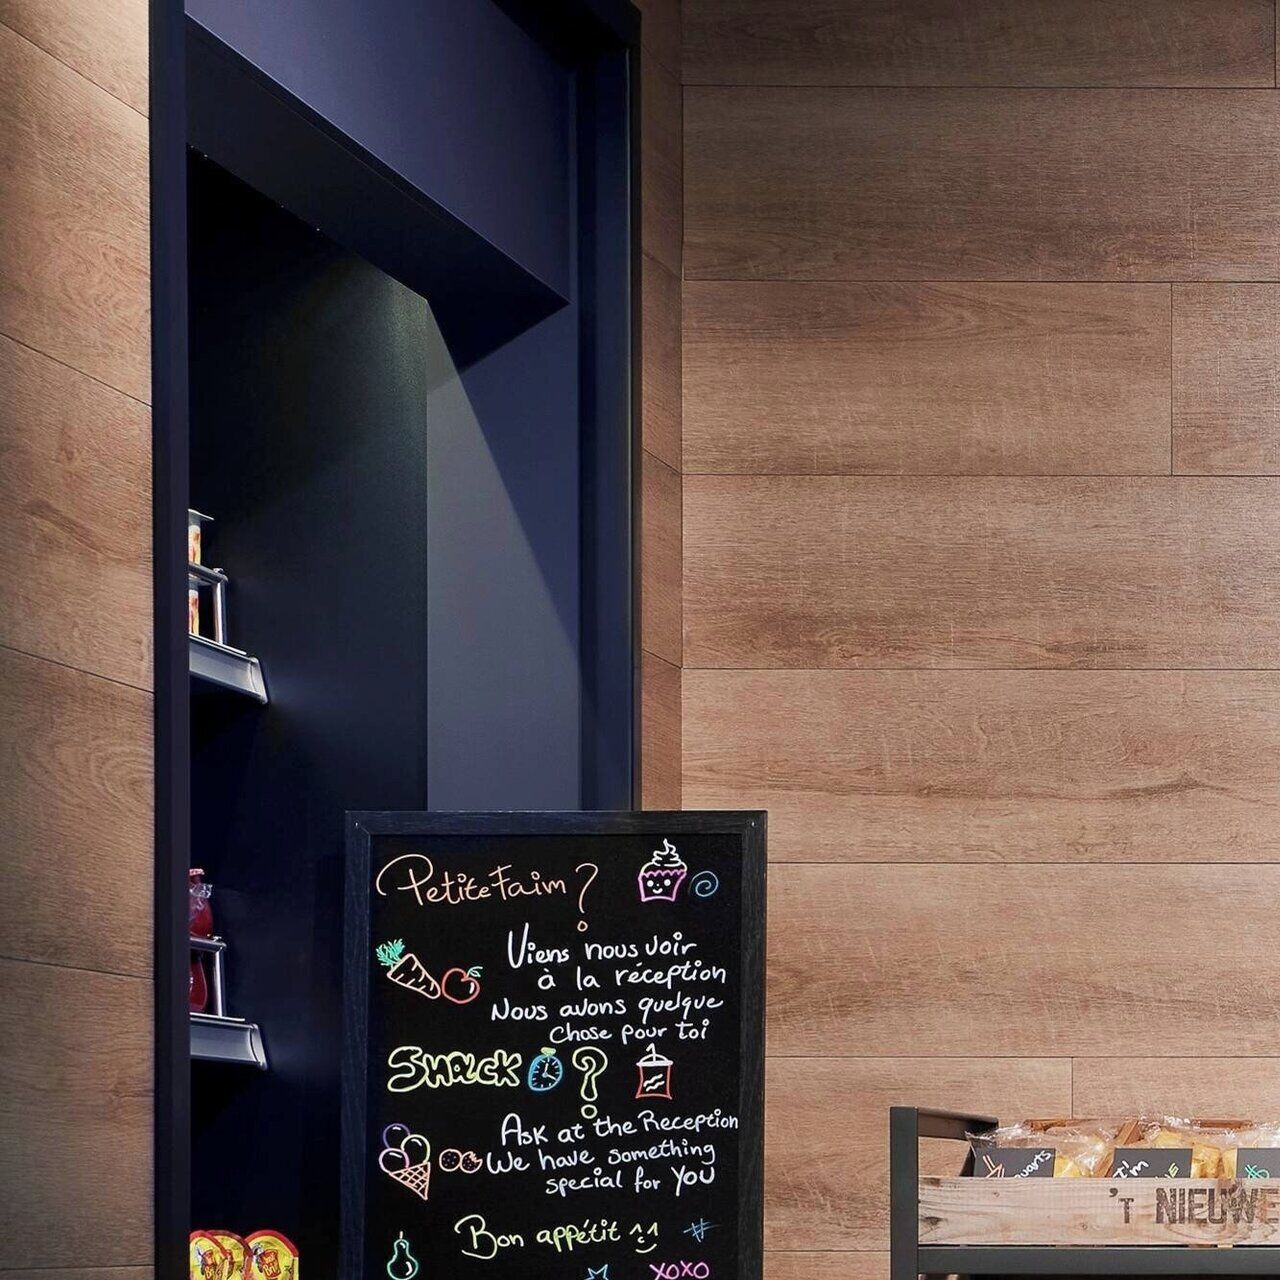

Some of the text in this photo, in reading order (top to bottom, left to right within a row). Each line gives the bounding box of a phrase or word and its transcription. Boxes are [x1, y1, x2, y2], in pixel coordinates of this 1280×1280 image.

[376, 854, 490, 907] Petite
[507, 923, 698, 969] Viens nous voir
[538, 960, 728, 991] à la réception
[491, 995, 724, 1025] Nous avons quelque
[622, 1024, 668, 1046] pour
[676, 1019, 710, 1041] toi
[558, 1121, 585, 1144] at
[594, 1116, 638, 1138] the
[638, 1108, 739, 1134] Reception
[486, 1139, 716, 1175] We have something
[545, 1168, 623, 1198] special
[634, 1169, 661, 1193] for
[1155, 1187, 1280, 1225] NIEUWE
[454, 1214, 622, 1260] Bon appétit
